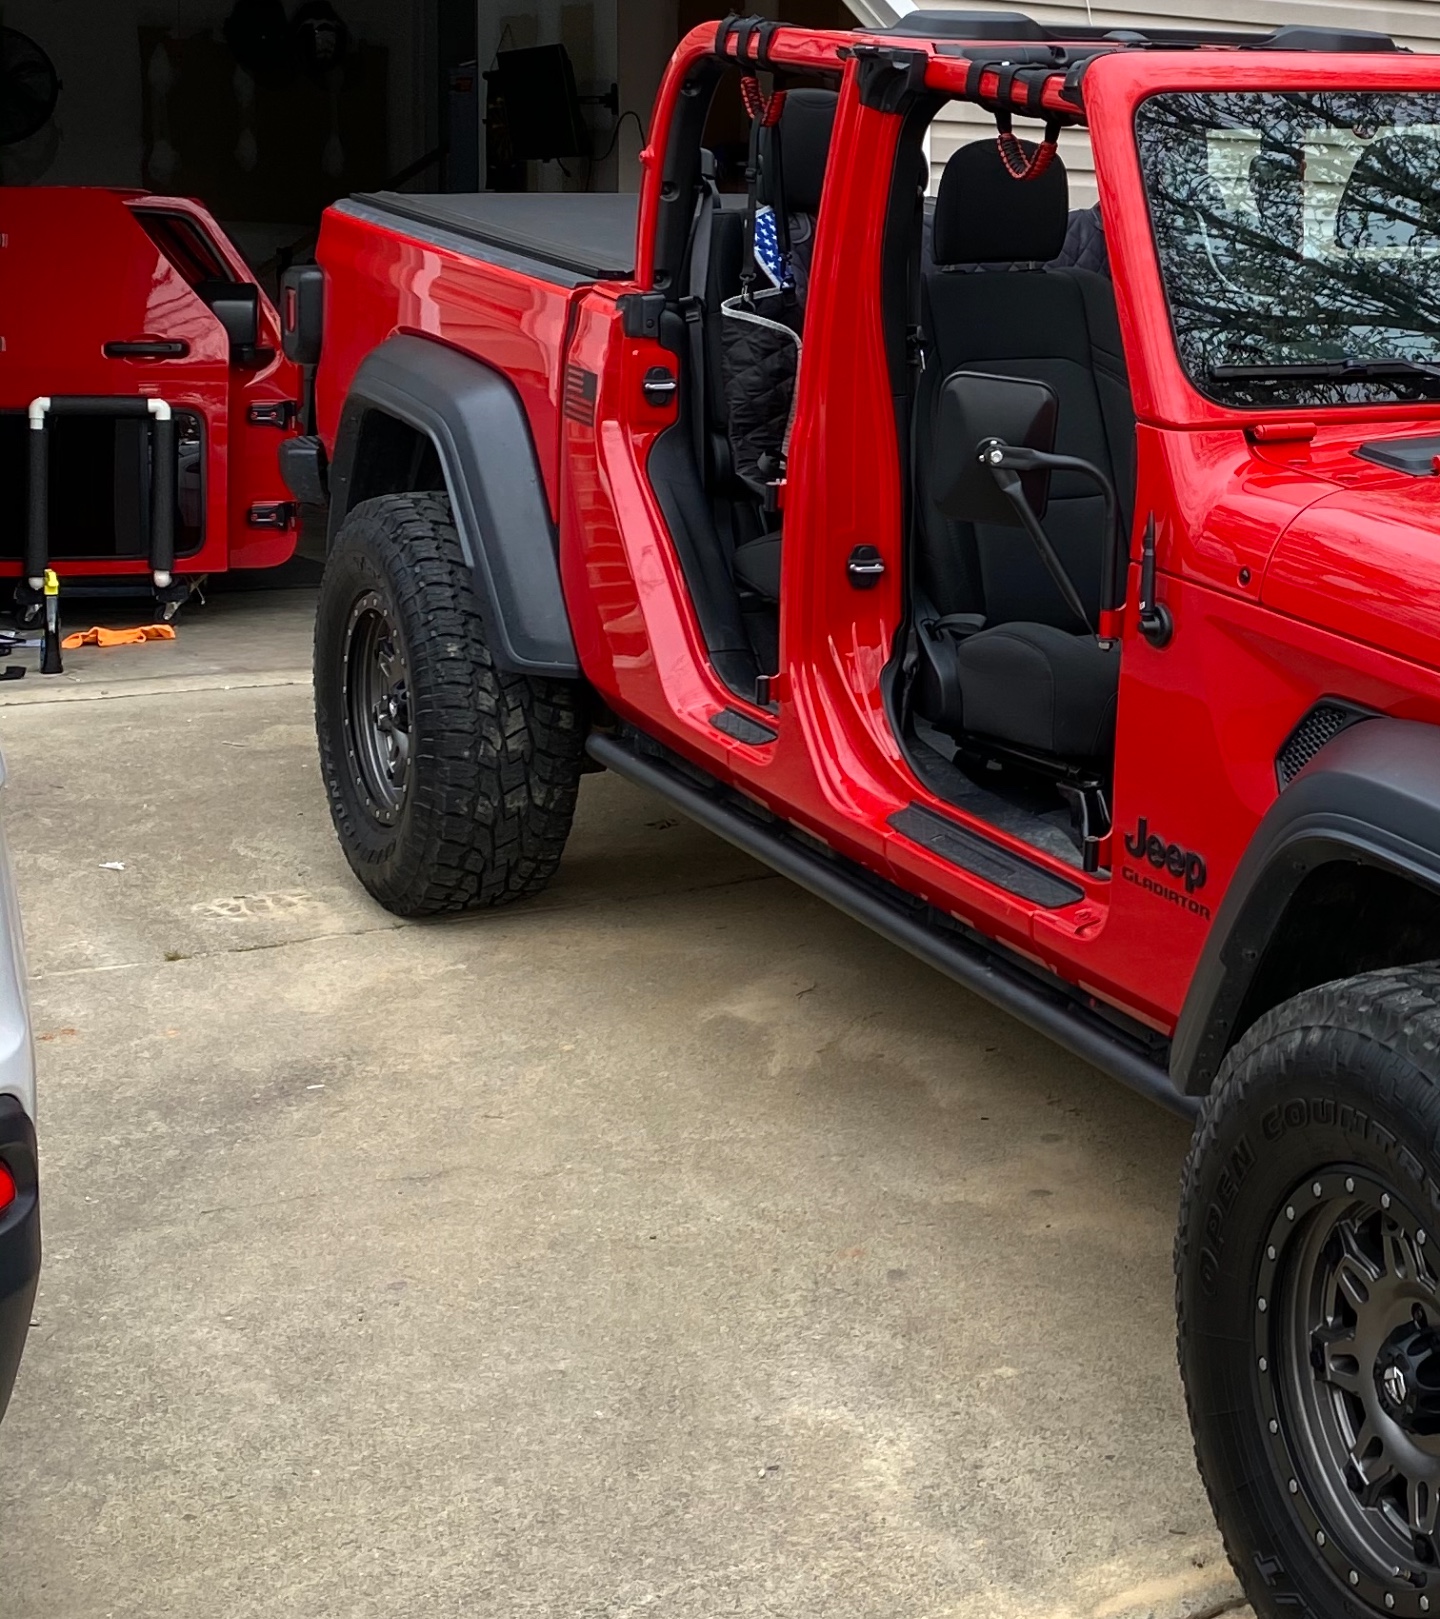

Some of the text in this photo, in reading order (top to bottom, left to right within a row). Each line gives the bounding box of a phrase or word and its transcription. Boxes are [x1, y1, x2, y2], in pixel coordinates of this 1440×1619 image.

[1124, 816, 1207, 893] Jeep
[1121, 866, 1211, 921] GLADIATOR
[1200, 1134, 1258, 1296] OPEN
